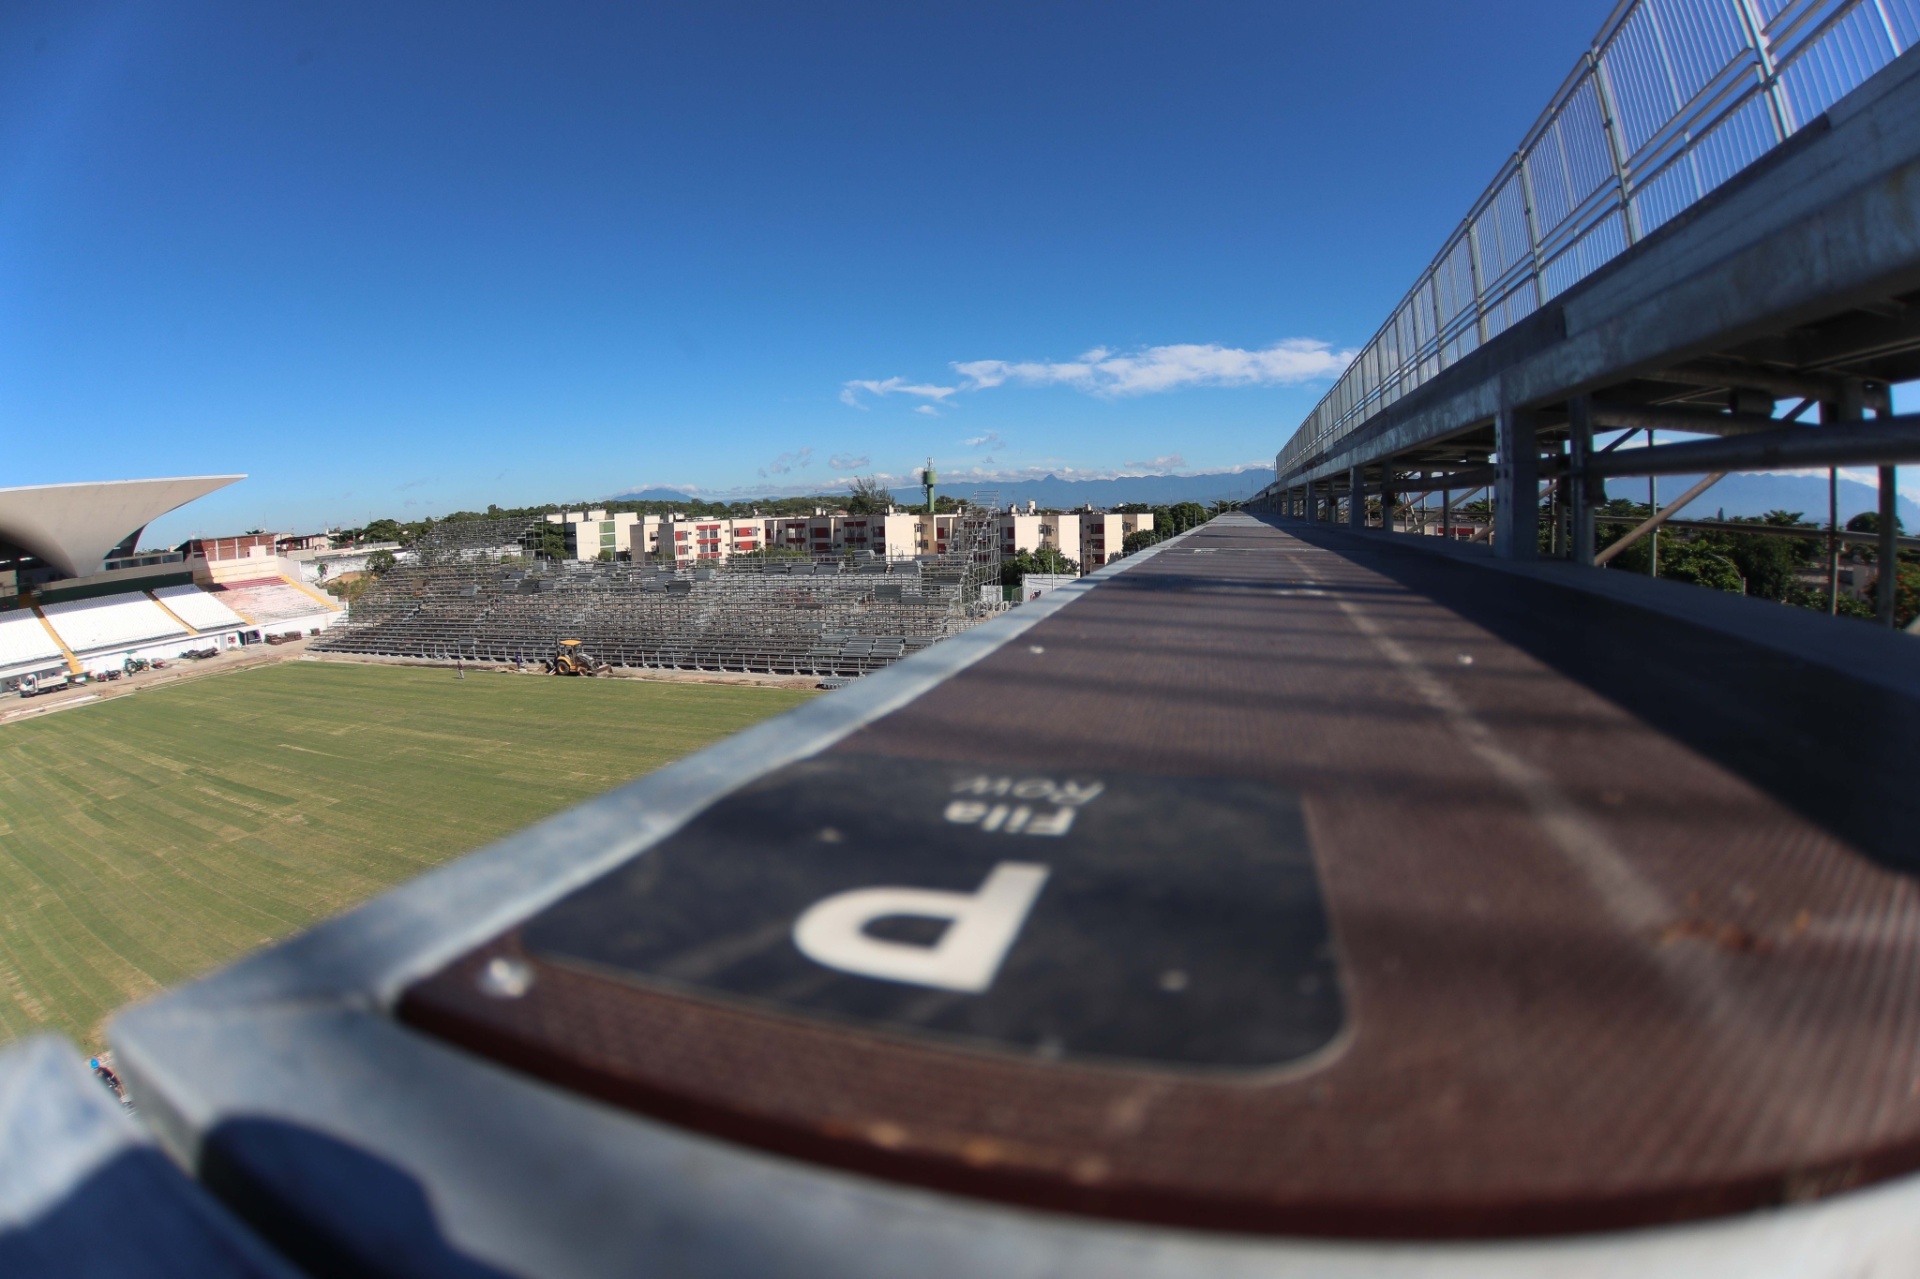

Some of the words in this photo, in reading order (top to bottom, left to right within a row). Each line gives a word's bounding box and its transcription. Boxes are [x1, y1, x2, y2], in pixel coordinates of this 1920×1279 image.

[951, 775, 1104, 805] Row
[944, 801, 1076, 836] Fila
[793, 861, 1050, 993] P
